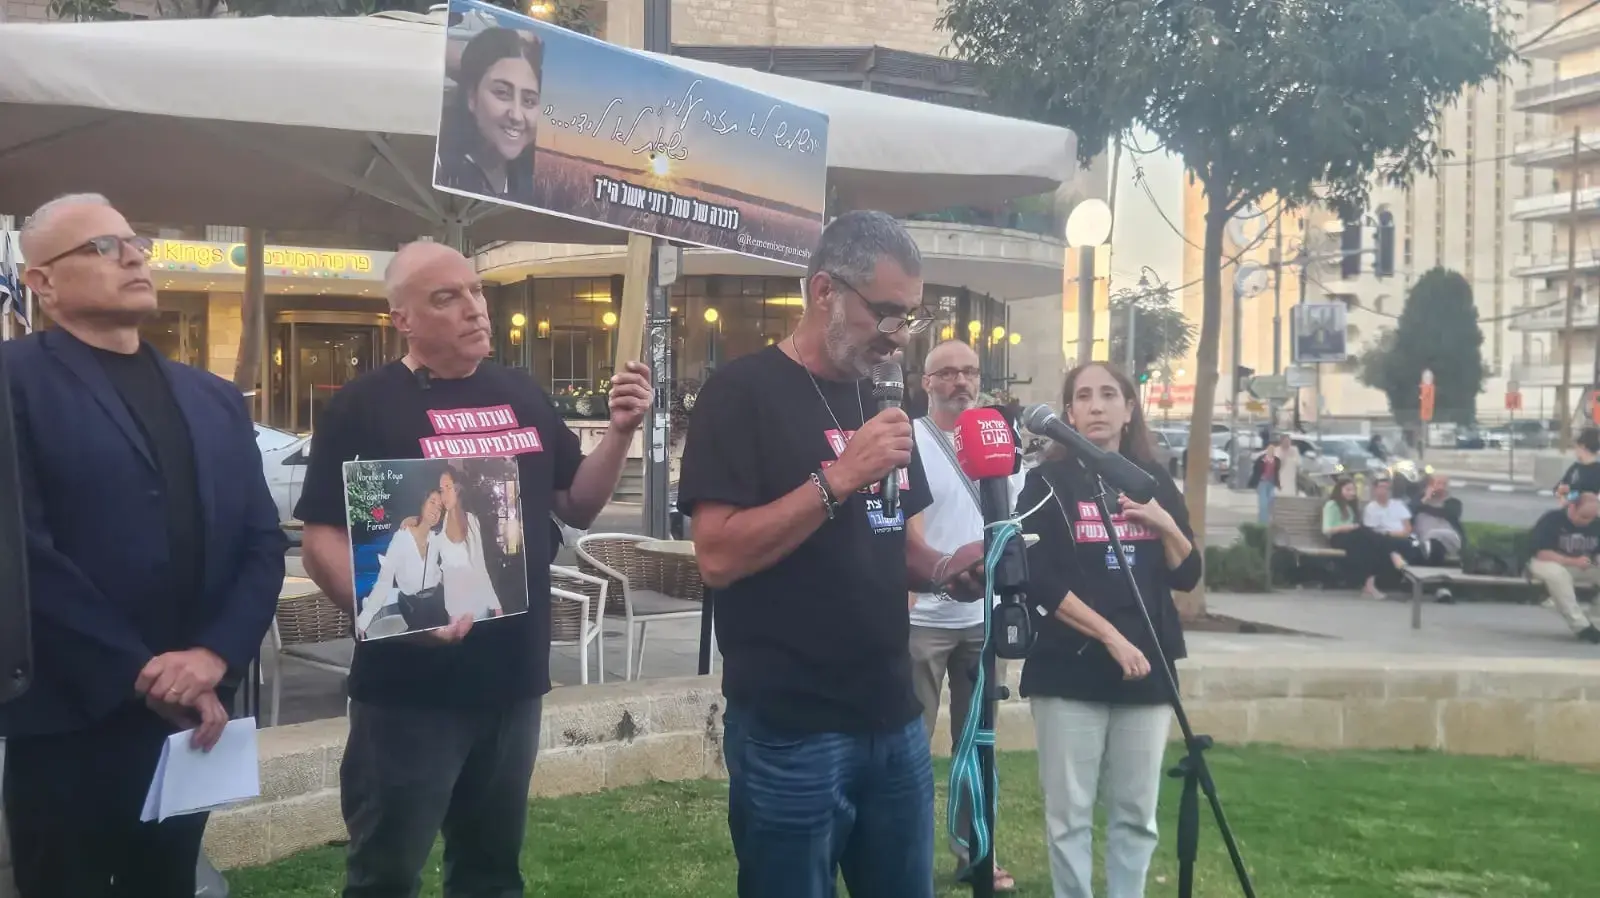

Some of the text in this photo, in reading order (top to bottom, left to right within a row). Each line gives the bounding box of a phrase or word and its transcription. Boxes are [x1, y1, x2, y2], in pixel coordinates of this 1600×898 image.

[611, 107, 653, 145] לא
[747, 105, 781, 139] לא
[621, 183, 646, 209] אשל
[648, 191, 667, 214] רוני
[669, 194, 690, 218] סמל
[692, 200, 708, 222] של
[709, 206, 739, 230] לזכרה
[166, 242, 224, 266] Kings
[434, 408, 514, 431] ועדת חקירה
[476, 431, 539, 454] ממלכתית
[366, 520, 391, 532] Forever
